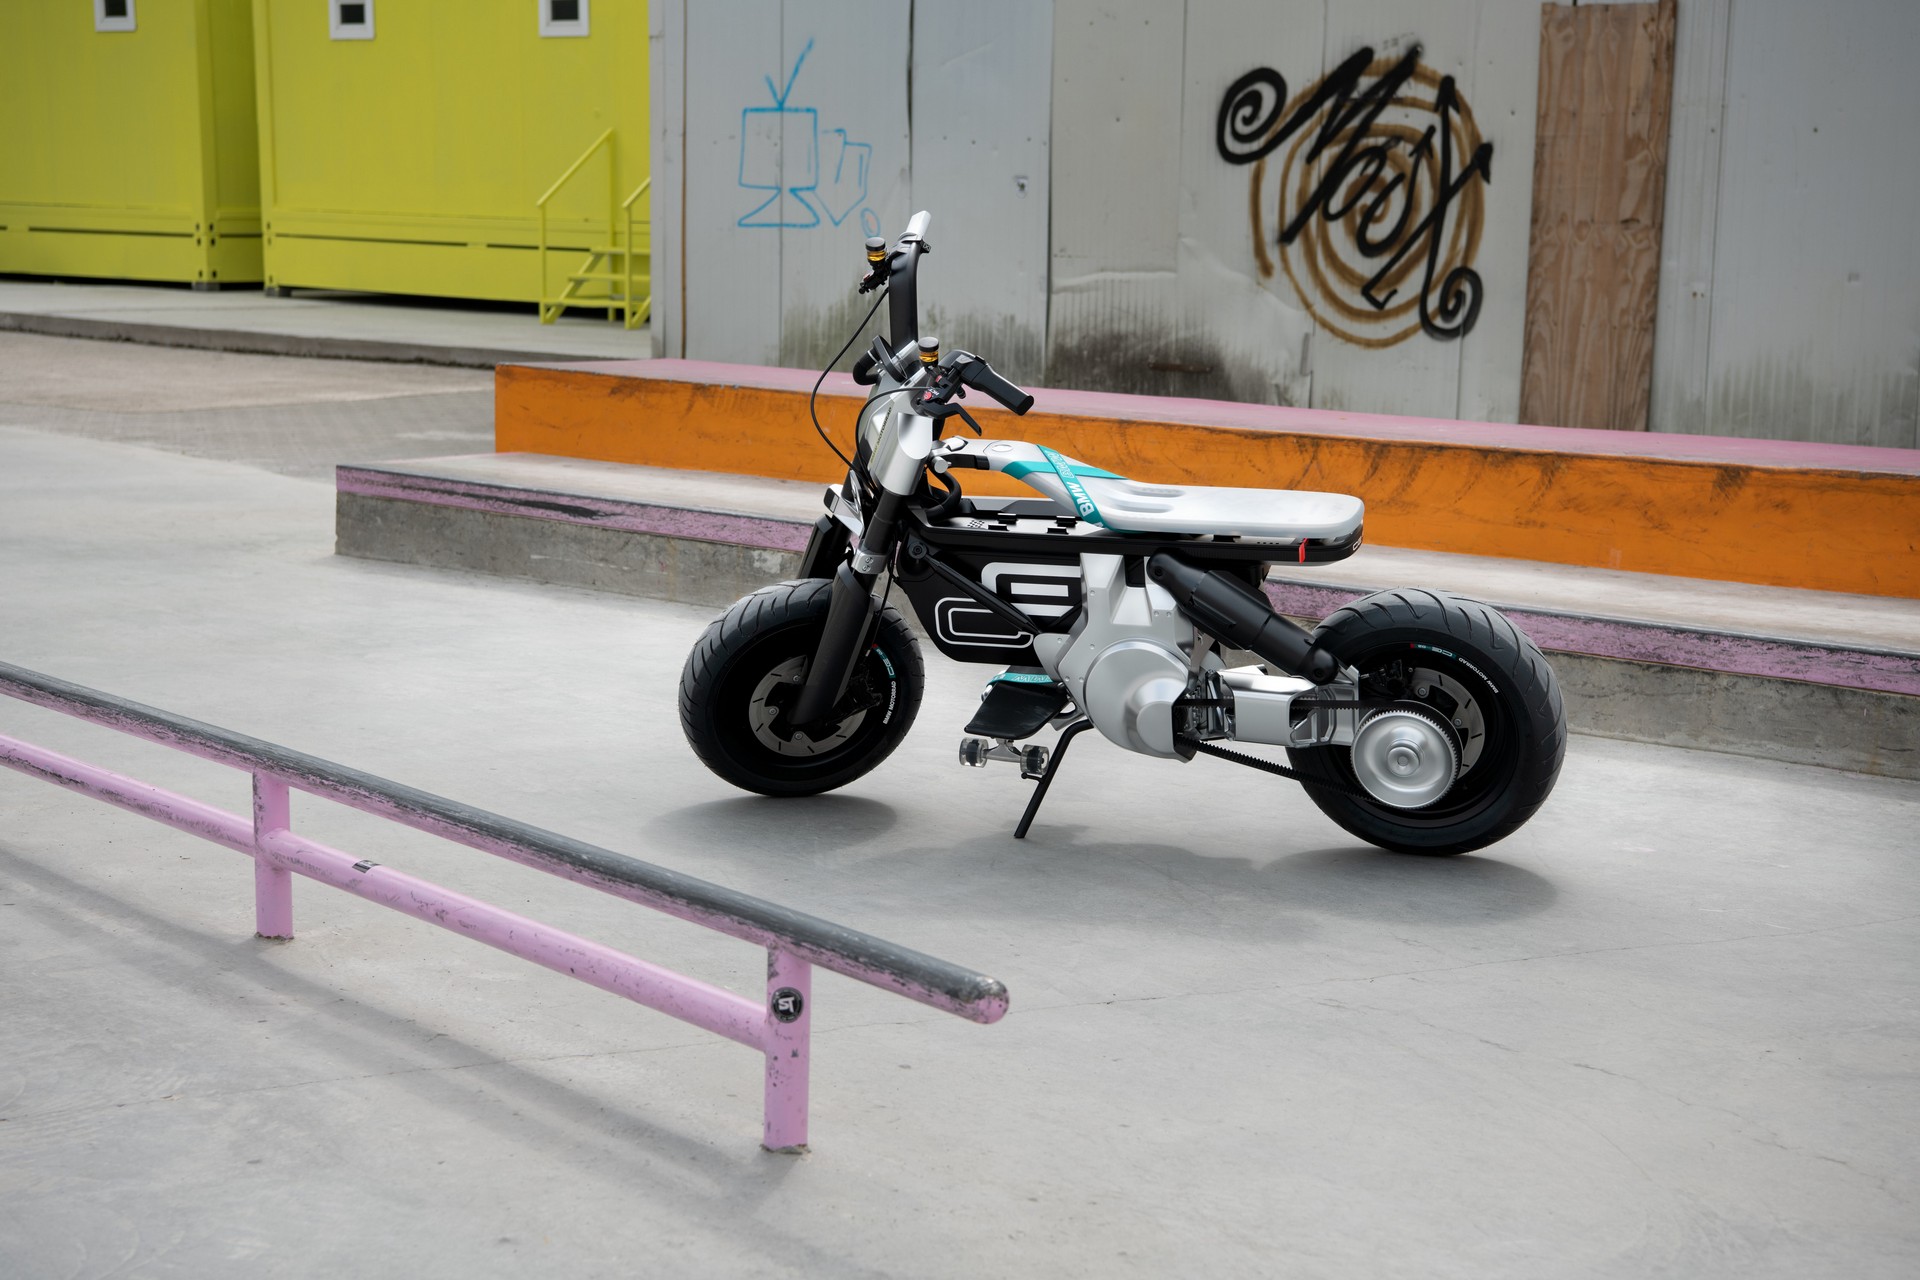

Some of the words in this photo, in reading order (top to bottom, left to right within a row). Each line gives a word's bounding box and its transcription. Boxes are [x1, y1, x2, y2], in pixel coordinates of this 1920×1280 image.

[1066, 481, 1095, 517] BMW
[1458, 657, 1488, 681] MOTORRAD
[1486, 680, 1499, 694] BMW
[882, 710, 892, 725] BMW
[888, 680, 897, 711] MOTORRAD
